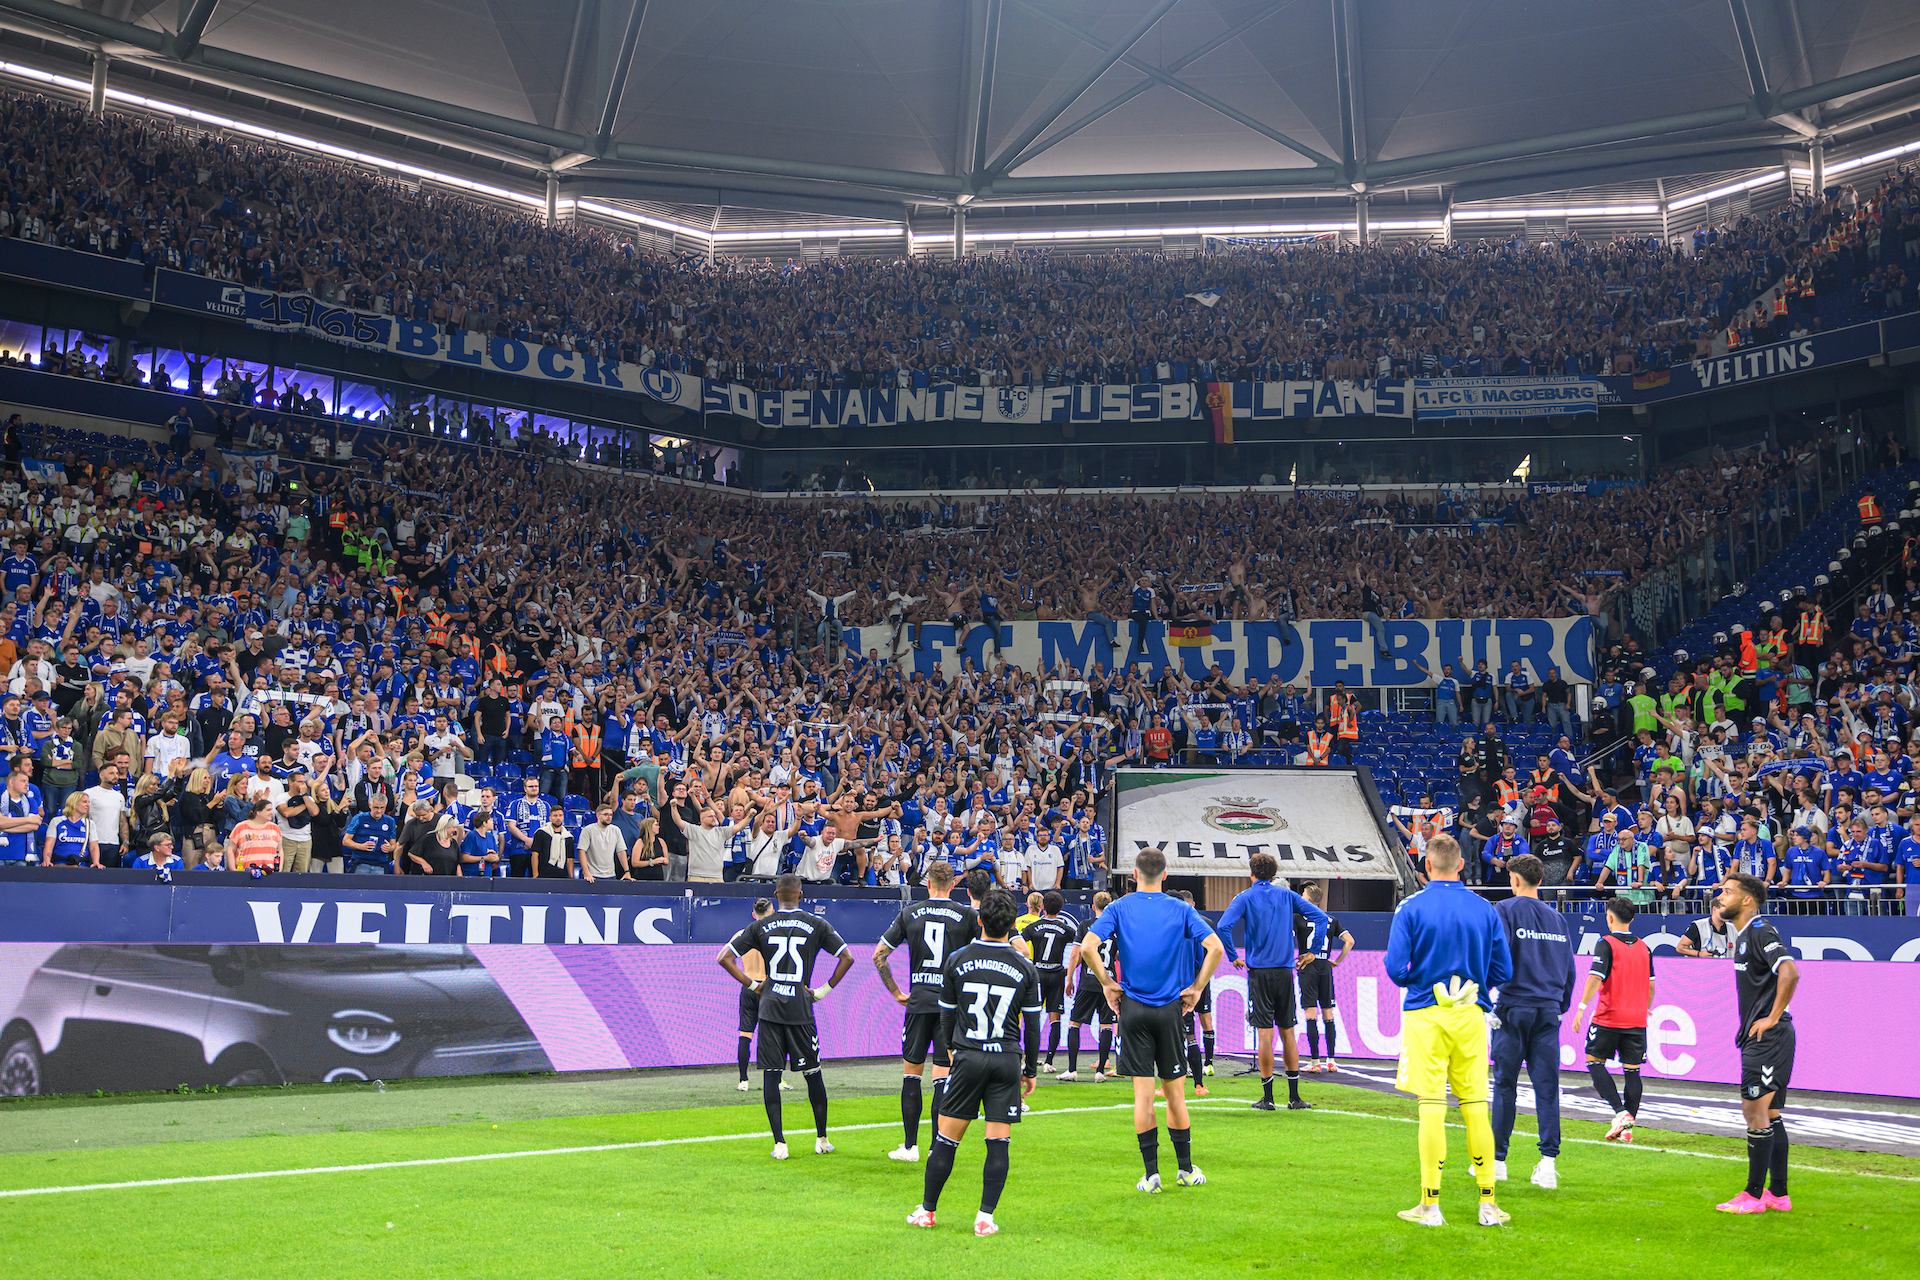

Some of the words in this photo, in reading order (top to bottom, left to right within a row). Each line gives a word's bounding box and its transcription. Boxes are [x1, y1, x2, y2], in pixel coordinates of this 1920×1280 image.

[206, 301, 240, 315] VELTINS
[395, 315, 624, 388] BLOCK
[1696, 340, 1815, 388] VELTINS
[705, 382, 983, 429] SOGENANNTE
[1042, 379, 1405, 423] FUSSBLLFANS
[1482, 387, 1595, 403] MAGDEBURG
[1598, 395, 1622, 403] RENA
[1133, 840, 1375, 863] VELTINS
[926, 906, 964, 923] MAGDEBURG
[777, 919, 815, 935] MAGDEBURG
[1526, 929, 1567, 943] Humanas
[922, 920, 946, 968] 9
[1041, 932, 1056, 961] 7
[767, 936, 808, 982] 25
[974, 958, 1024, 983] MAGDEBURG
[771, 983, 796, 997] GNAKA
[911, 972, 944, 986] CASTAIG
[962, 982, 1017, 1040] 37
